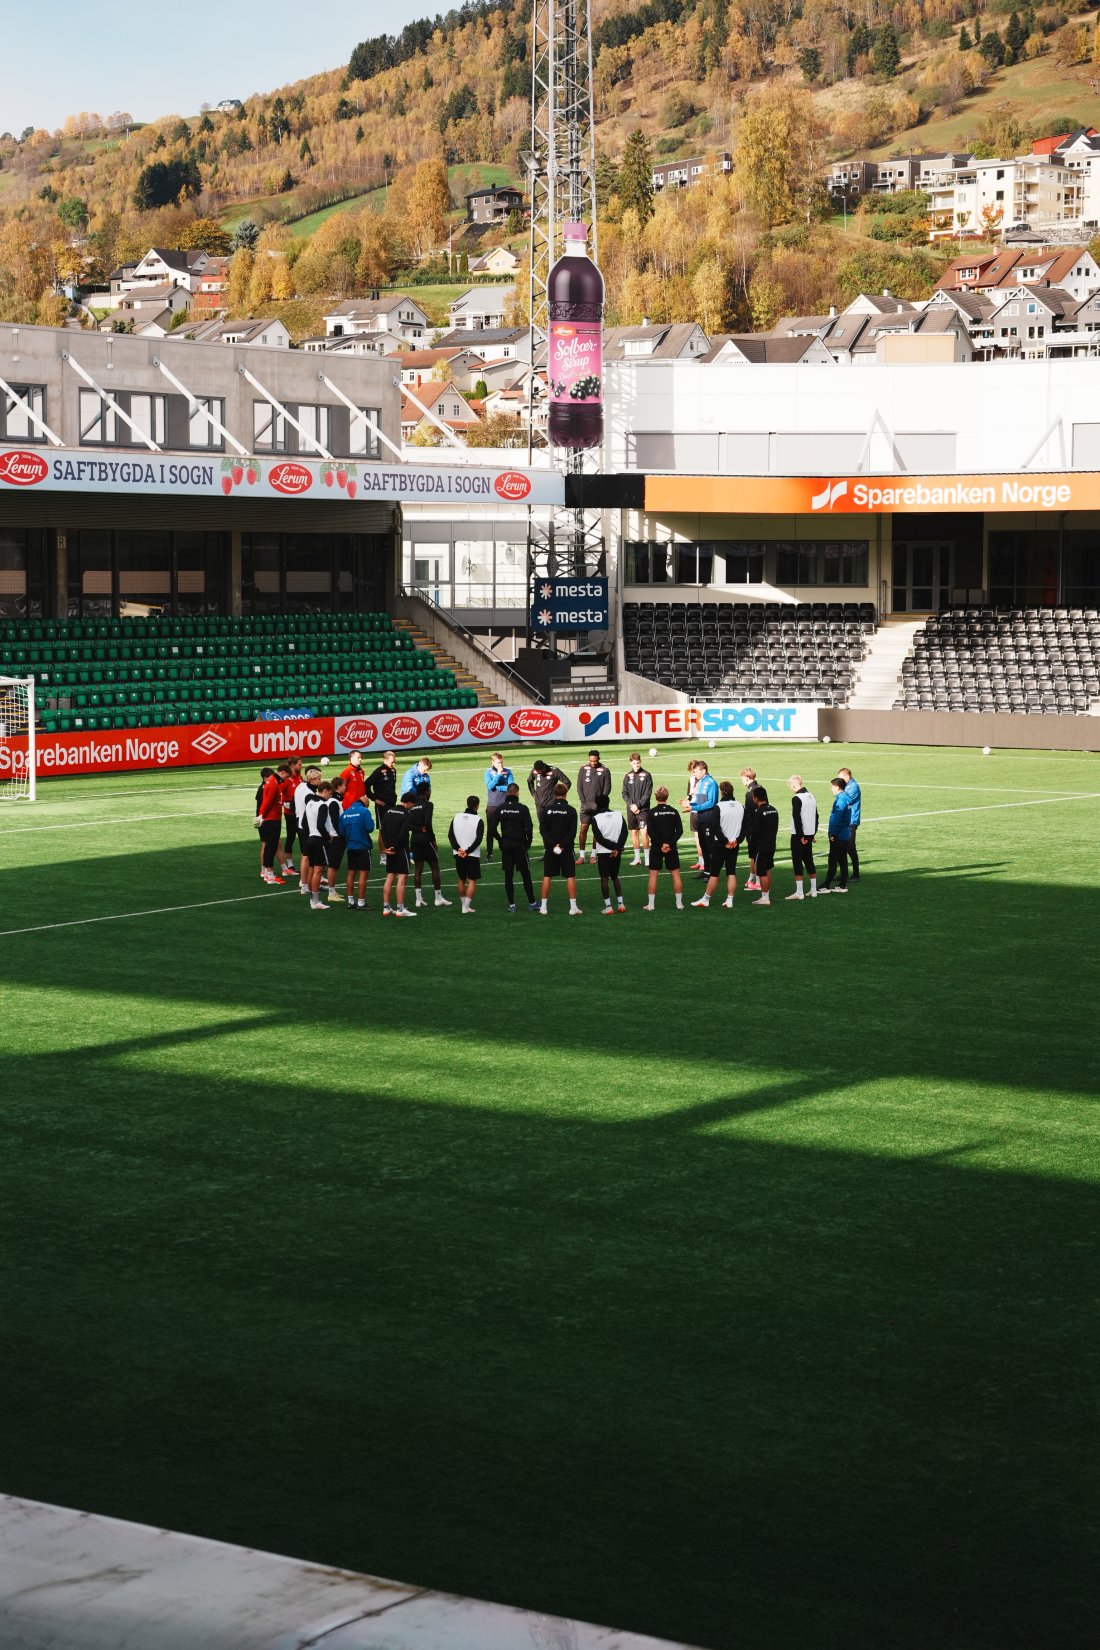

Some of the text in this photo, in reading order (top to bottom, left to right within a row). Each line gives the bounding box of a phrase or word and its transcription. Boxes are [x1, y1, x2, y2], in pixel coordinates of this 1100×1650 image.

[562, 357, 589, 370] Sirup
[0, 454, 42, 482] Lerum
[53, 460, 213, 485] SAFTBYGDA I SOGN
[271, 466, 308, 491] Lerum
[363, 472, 490, 494] SAFTBYGDA I SOGN
[496, 475, 527, 497] Lerum
[853, 482, 1071, 509] Sparebanken Norge
[555, 583, 603, 597] mesta
[555, 609, 603, 623] mesta
[384, 719, 417, 742] Lerum
[428, 717, 460, 739] Lerum
[470, 714, 501, 736] Lerum
[511, 712, 553, 734] Lerum
[614, 707, 796, 734] INTERSPORT
[250, 726, 322, 753] umbro
[340, 722, 374, 746] Lerum
[126, 738, 179, 764] Norge
